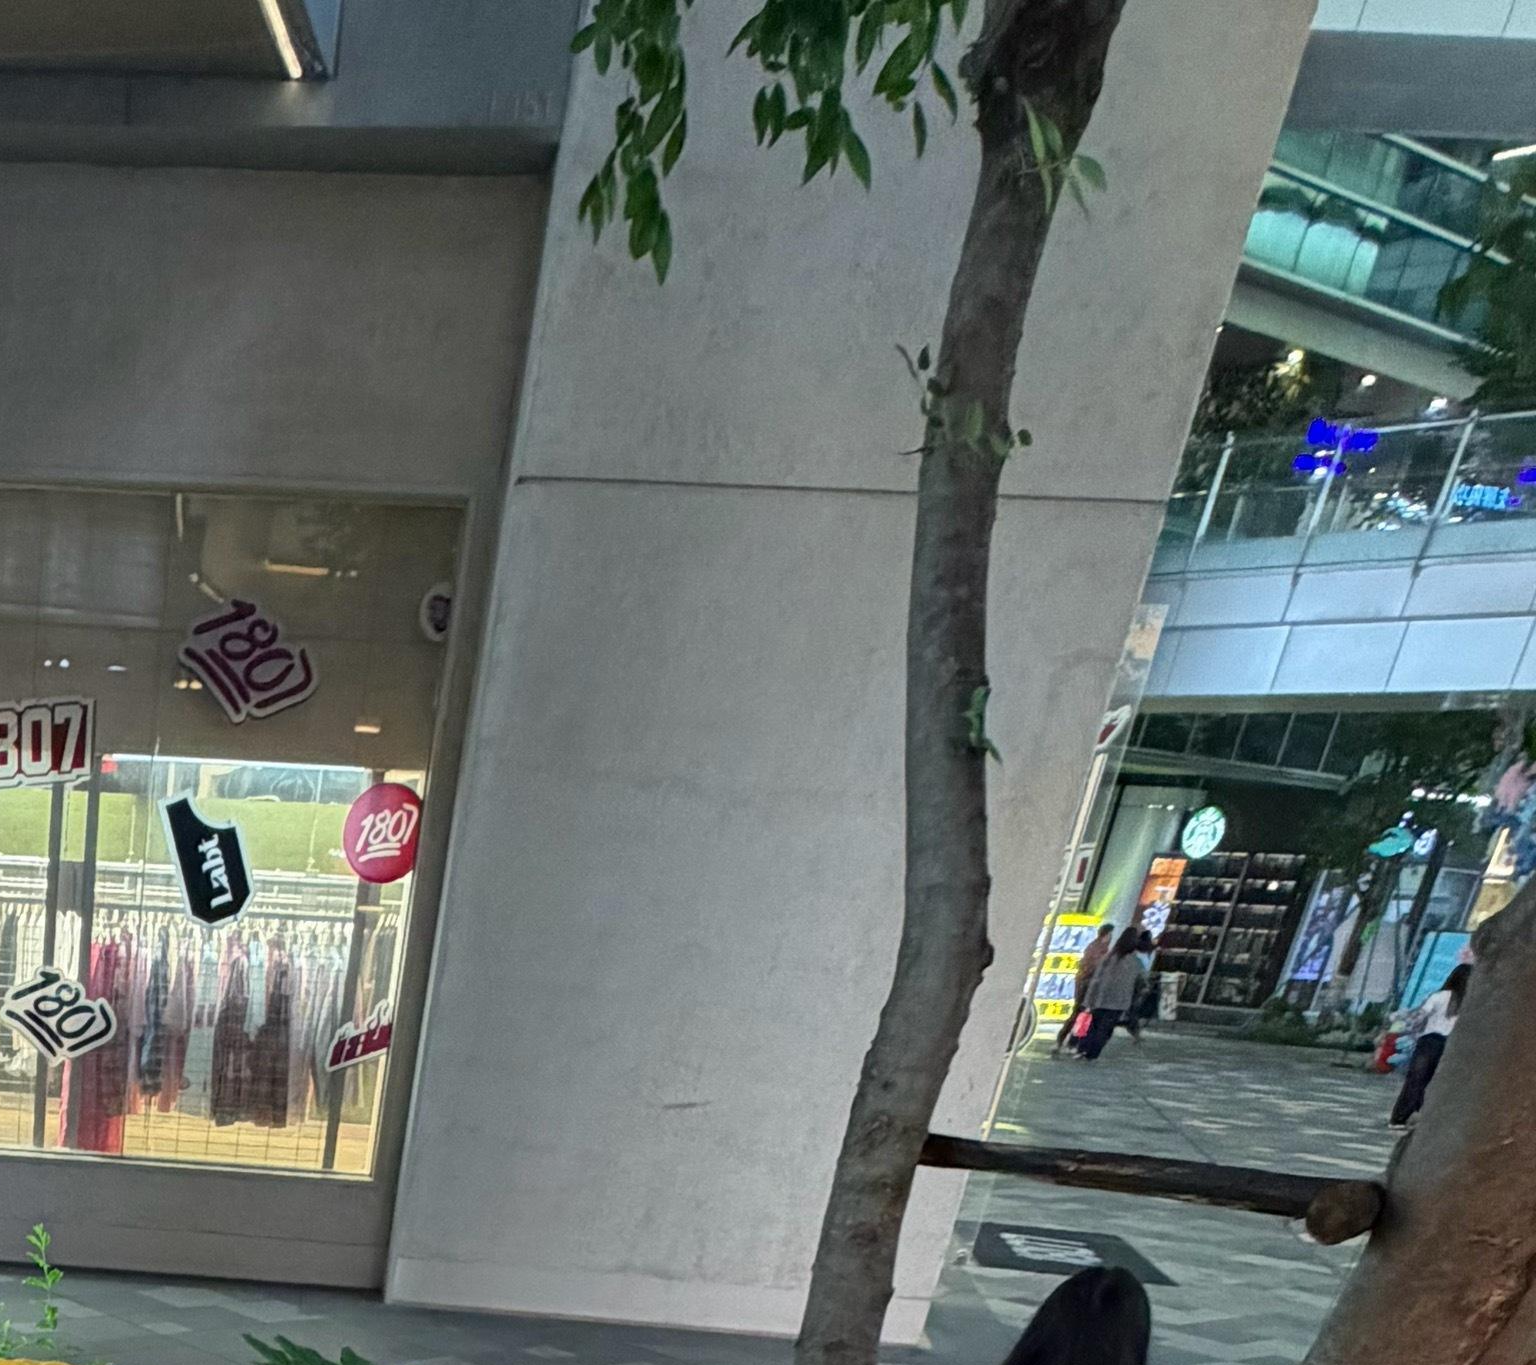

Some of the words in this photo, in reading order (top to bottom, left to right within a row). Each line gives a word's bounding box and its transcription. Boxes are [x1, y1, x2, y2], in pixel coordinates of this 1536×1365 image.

[192, 598, 314, 710] 1807
[355, 801, 419, 852] 1807
[10, 970, 112, 1053] 1807
